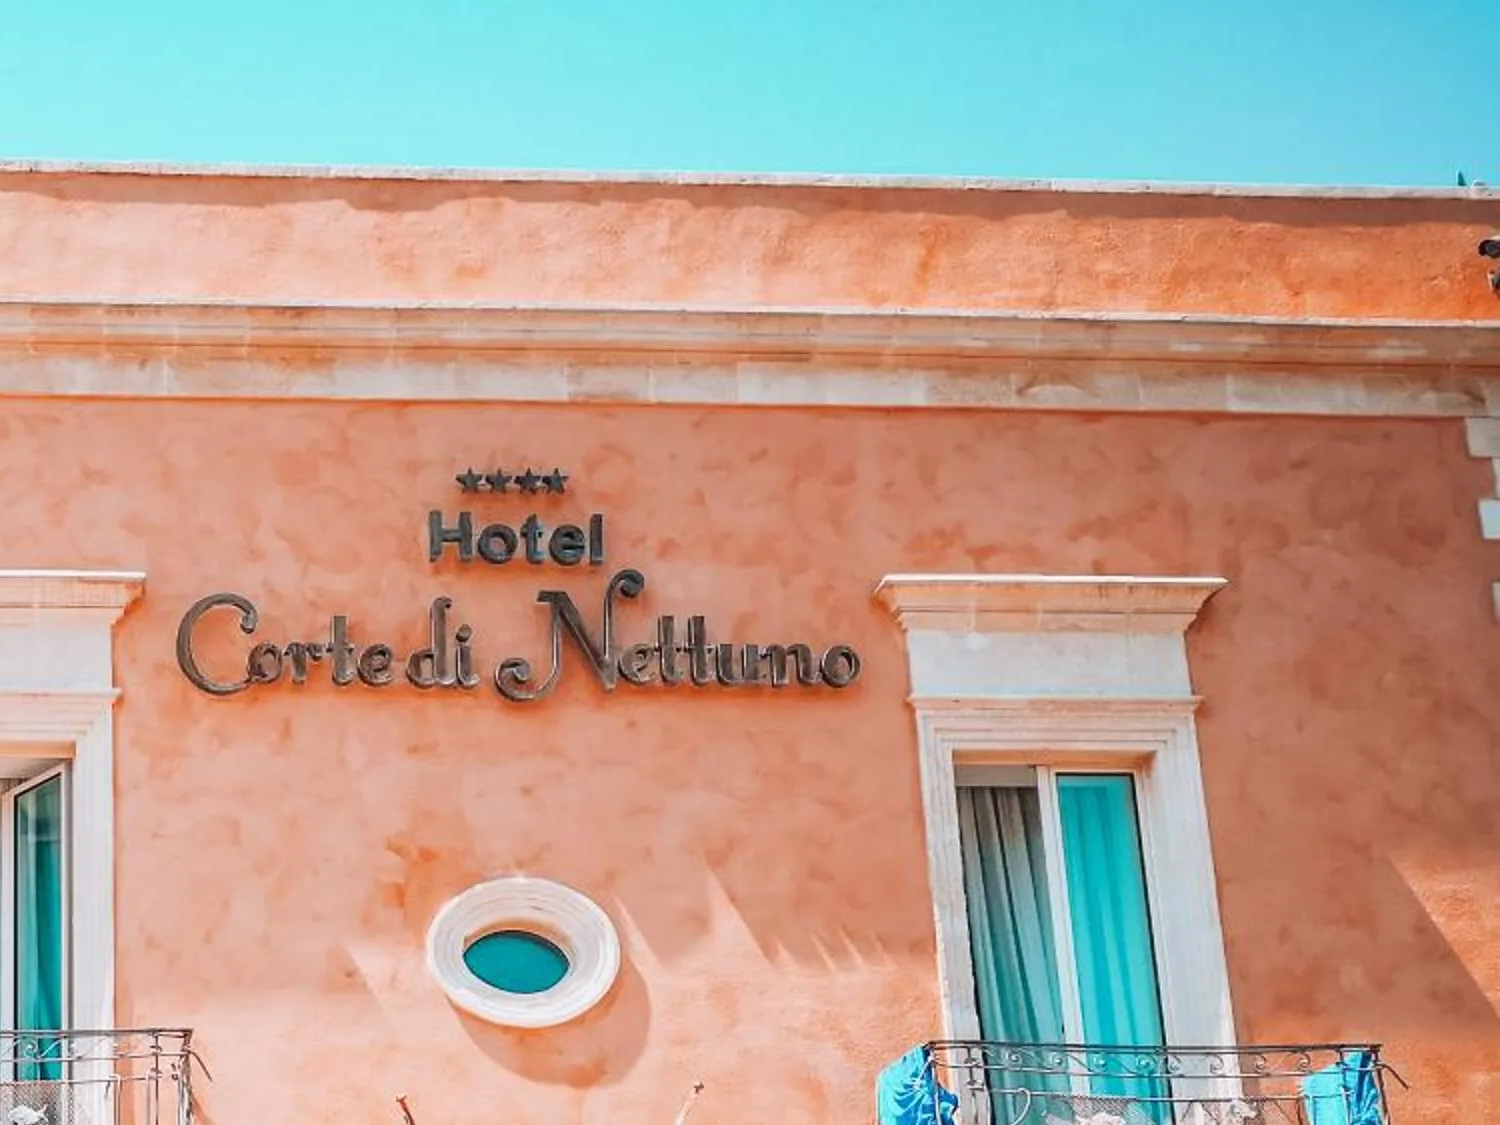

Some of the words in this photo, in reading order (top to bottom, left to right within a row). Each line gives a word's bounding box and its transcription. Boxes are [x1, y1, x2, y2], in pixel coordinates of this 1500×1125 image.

[428, 510, 603, 566] Hotel
[176, 593, 394, 696] Corte
[406, 596, 480, 689] di
[494, 569, 861, 701] Nettuno
